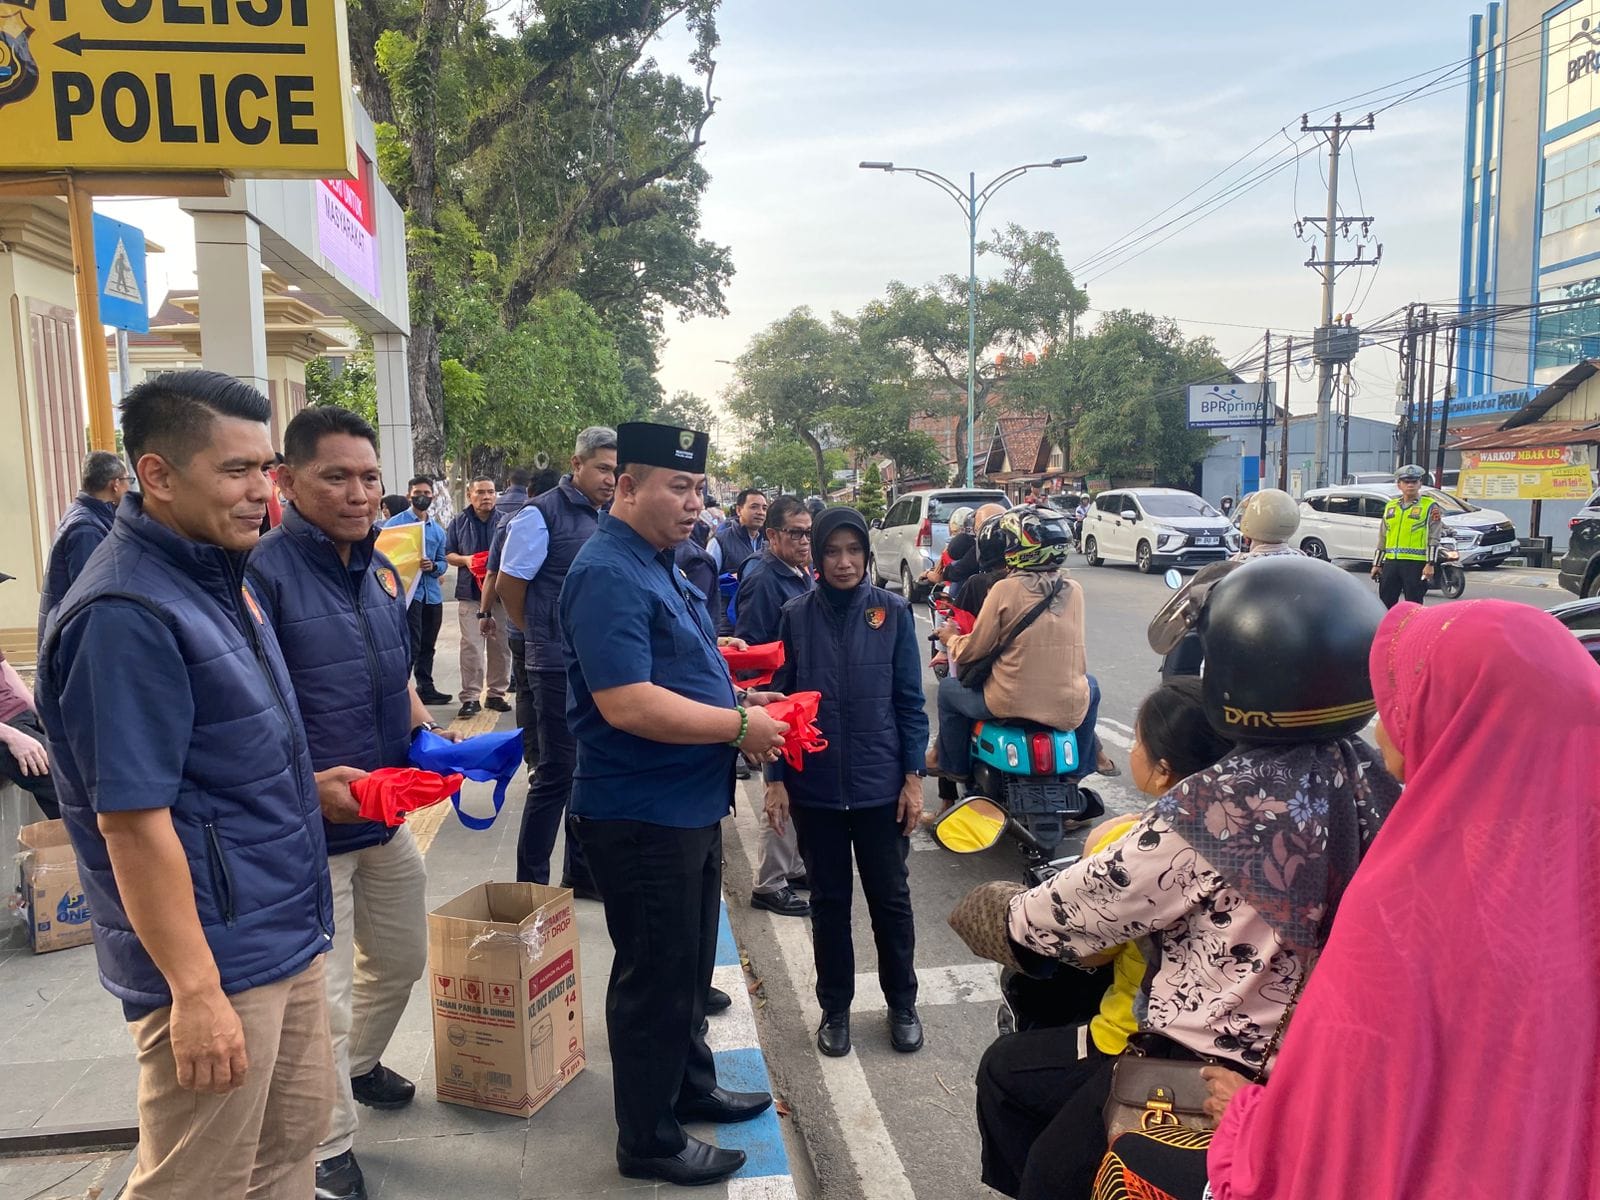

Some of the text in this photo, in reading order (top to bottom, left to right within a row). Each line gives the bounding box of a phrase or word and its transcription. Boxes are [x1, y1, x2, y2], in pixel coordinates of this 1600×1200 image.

[52, 71, 318, 145] POLICE
[1480, 449, 1560, 462] WARKOP MBAK US
[1222, 705, 1276, 727] DYR
[551, 917, 571, 938] DROP
[565, 972, 576, 991] USA
[565, 989, 577, 1007] 14
